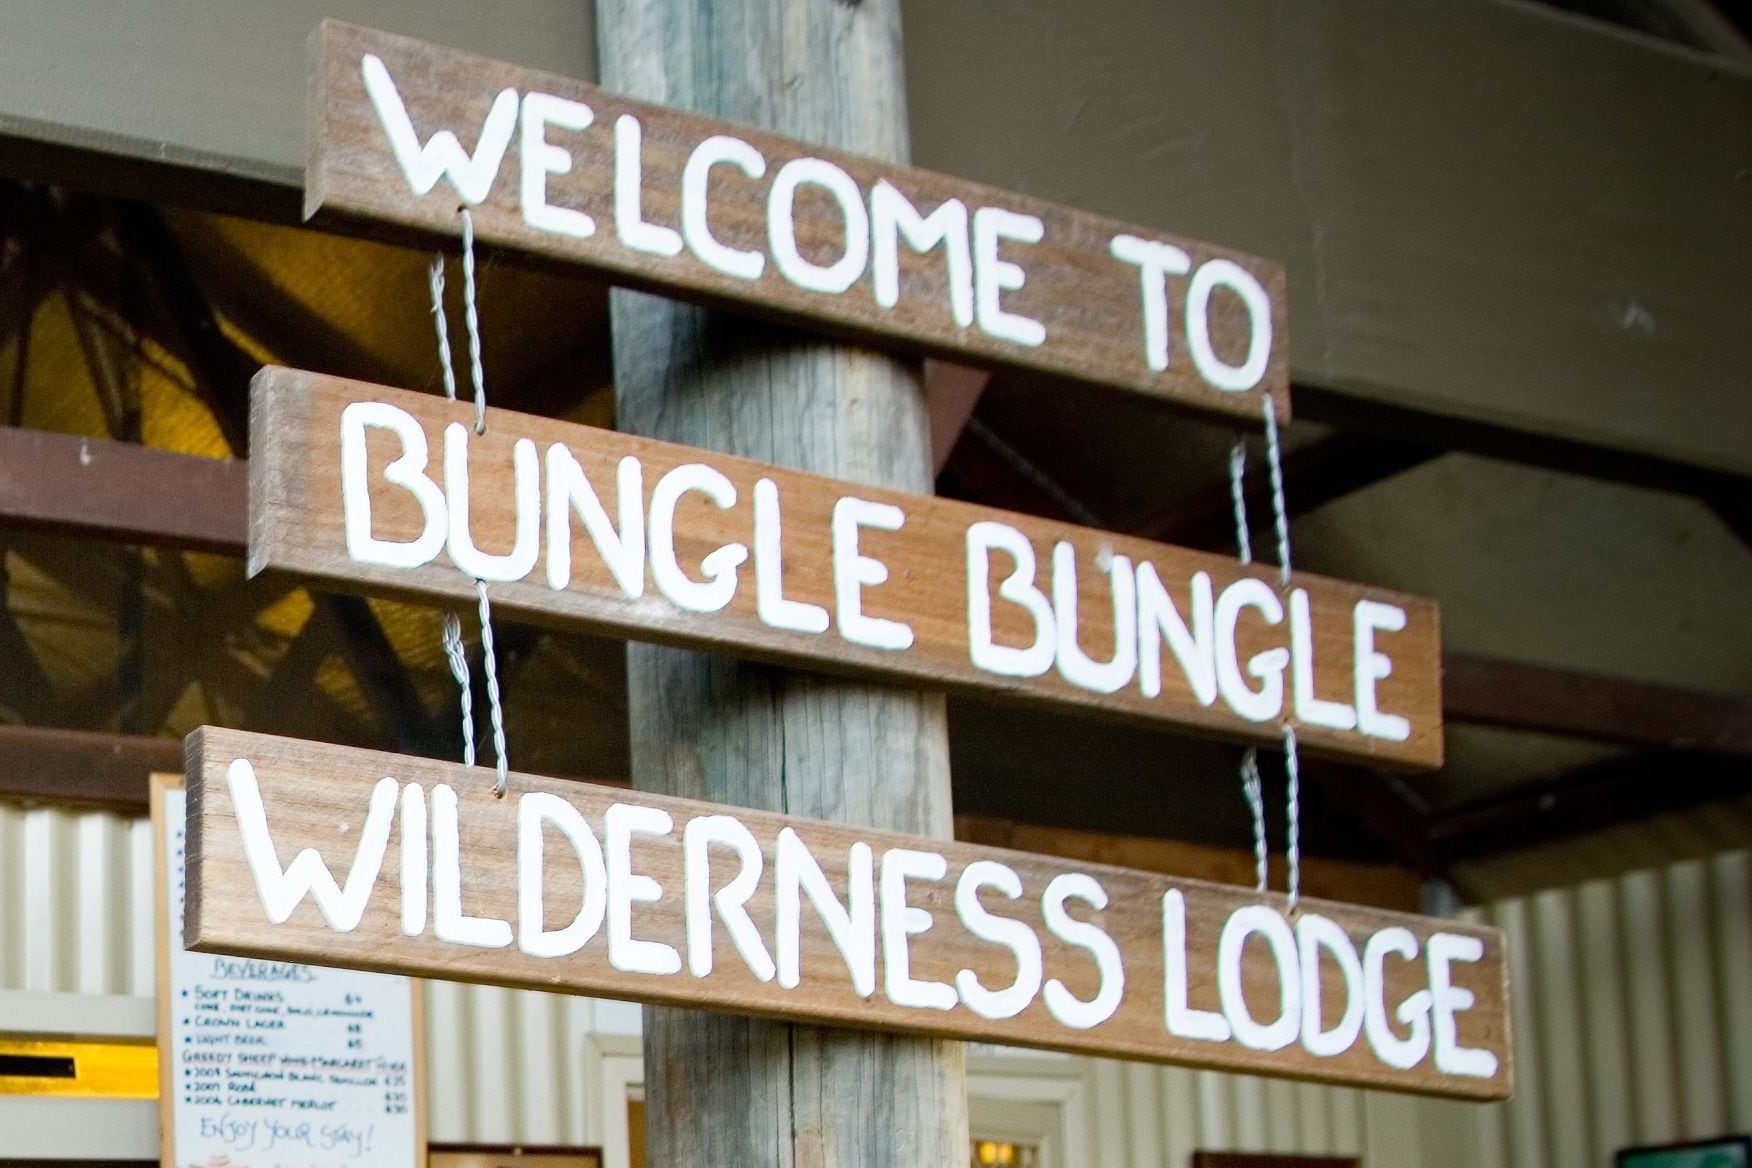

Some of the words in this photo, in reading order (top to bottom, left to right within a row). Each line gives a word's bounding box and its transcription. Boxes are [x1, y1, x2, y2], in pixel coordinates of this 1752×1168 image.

[360, 54, 1048, 347] WELCOME
[1110, 233, 1274, 393] TO
[339, 401, 914, 650] BUNGLE
[966, 520, 1411, 743] BUNGLE
[213, 958, 315, 983] BEVERAGES
[228, 757, 1124, 1031] WILDERNESS
[1161, 888, 1499, 1079] LODGE
